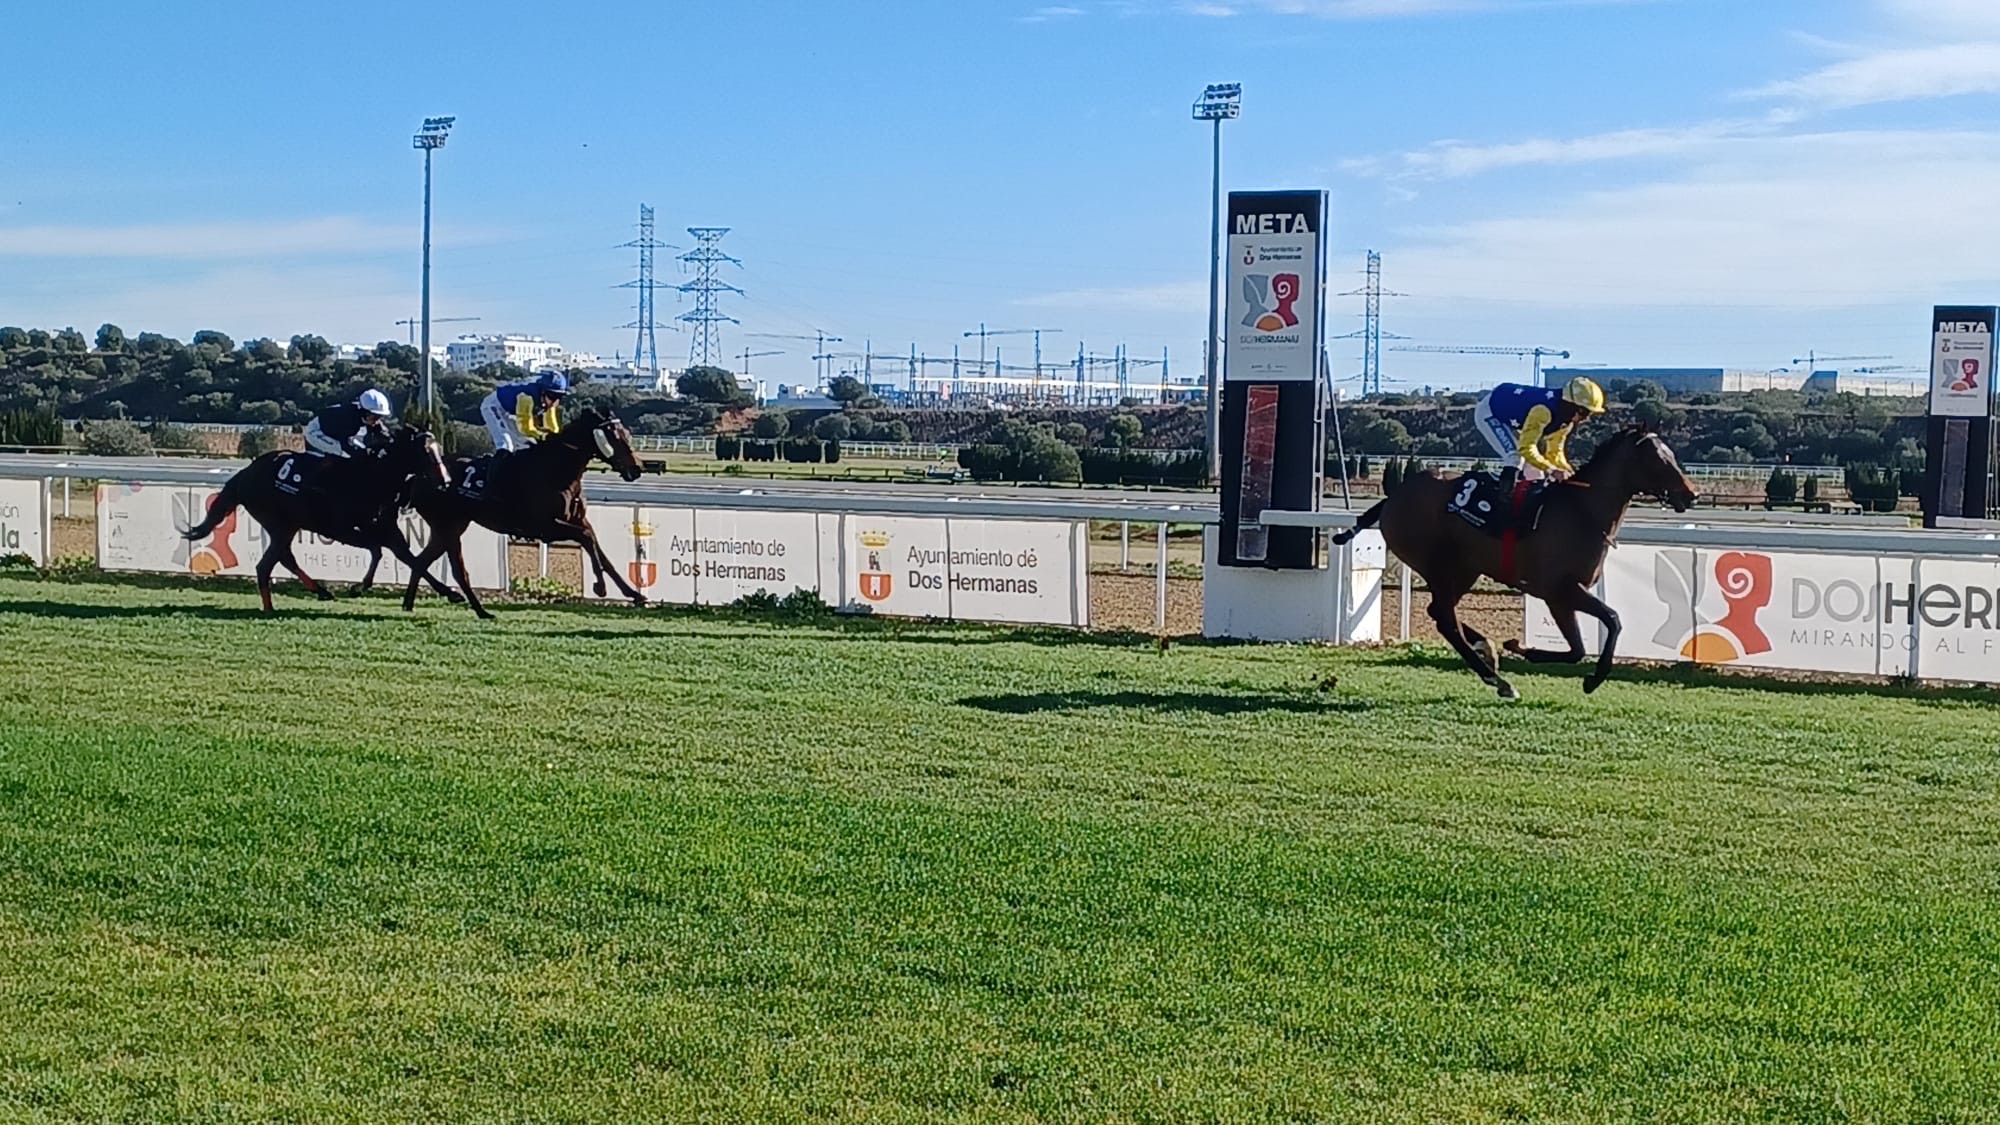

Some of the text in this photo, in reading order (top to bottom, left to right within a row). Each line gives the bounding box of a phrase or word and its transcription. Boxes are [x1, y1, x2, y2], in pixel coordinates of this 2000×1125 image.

[1236, 213, 1309, 234] META
[1939, 321, 1988, 333] META
[277, 458, 294, 480] 6
[463, 466, 476, 488] 2
[1455, 479, 1478, 507] 3
[670, 535, 786, 557] Ayuntamiento de
[907, 545, 1038, 568] Ayuntamiento de
[671, 558, 786, 581] Dos Hermanas
[908, 570, 1038, 594] Dos Hermanas
[1790, 628, 1918, 652] MIRANDO
[1935, 637, 1966, 654] AL
